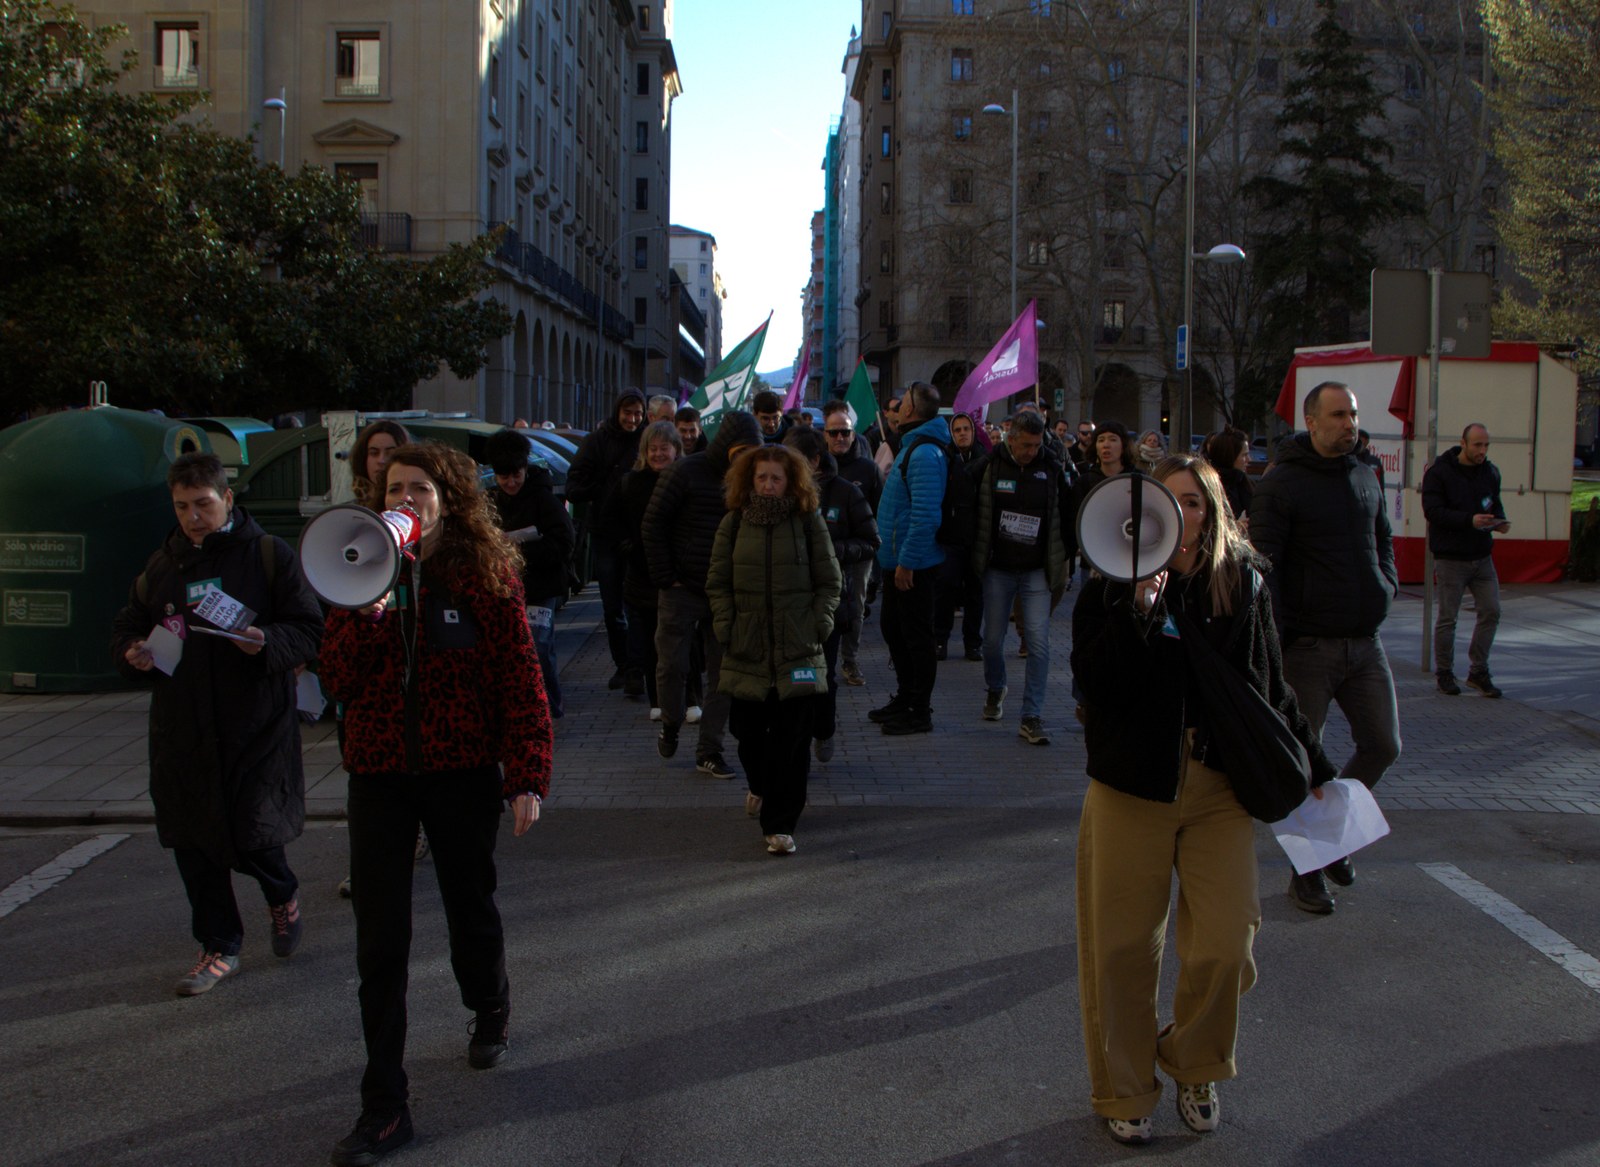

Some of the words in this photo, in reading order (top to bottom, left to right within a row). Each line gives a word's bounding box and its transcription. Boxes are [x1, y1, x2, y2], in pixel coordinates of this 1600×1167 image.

[997, 480, 1013, 489] ELA
[30, 539, 64, 552] vidrio
[24, 554, 78, 567] bakarrik
[794, 670, 814, 680] ELA
